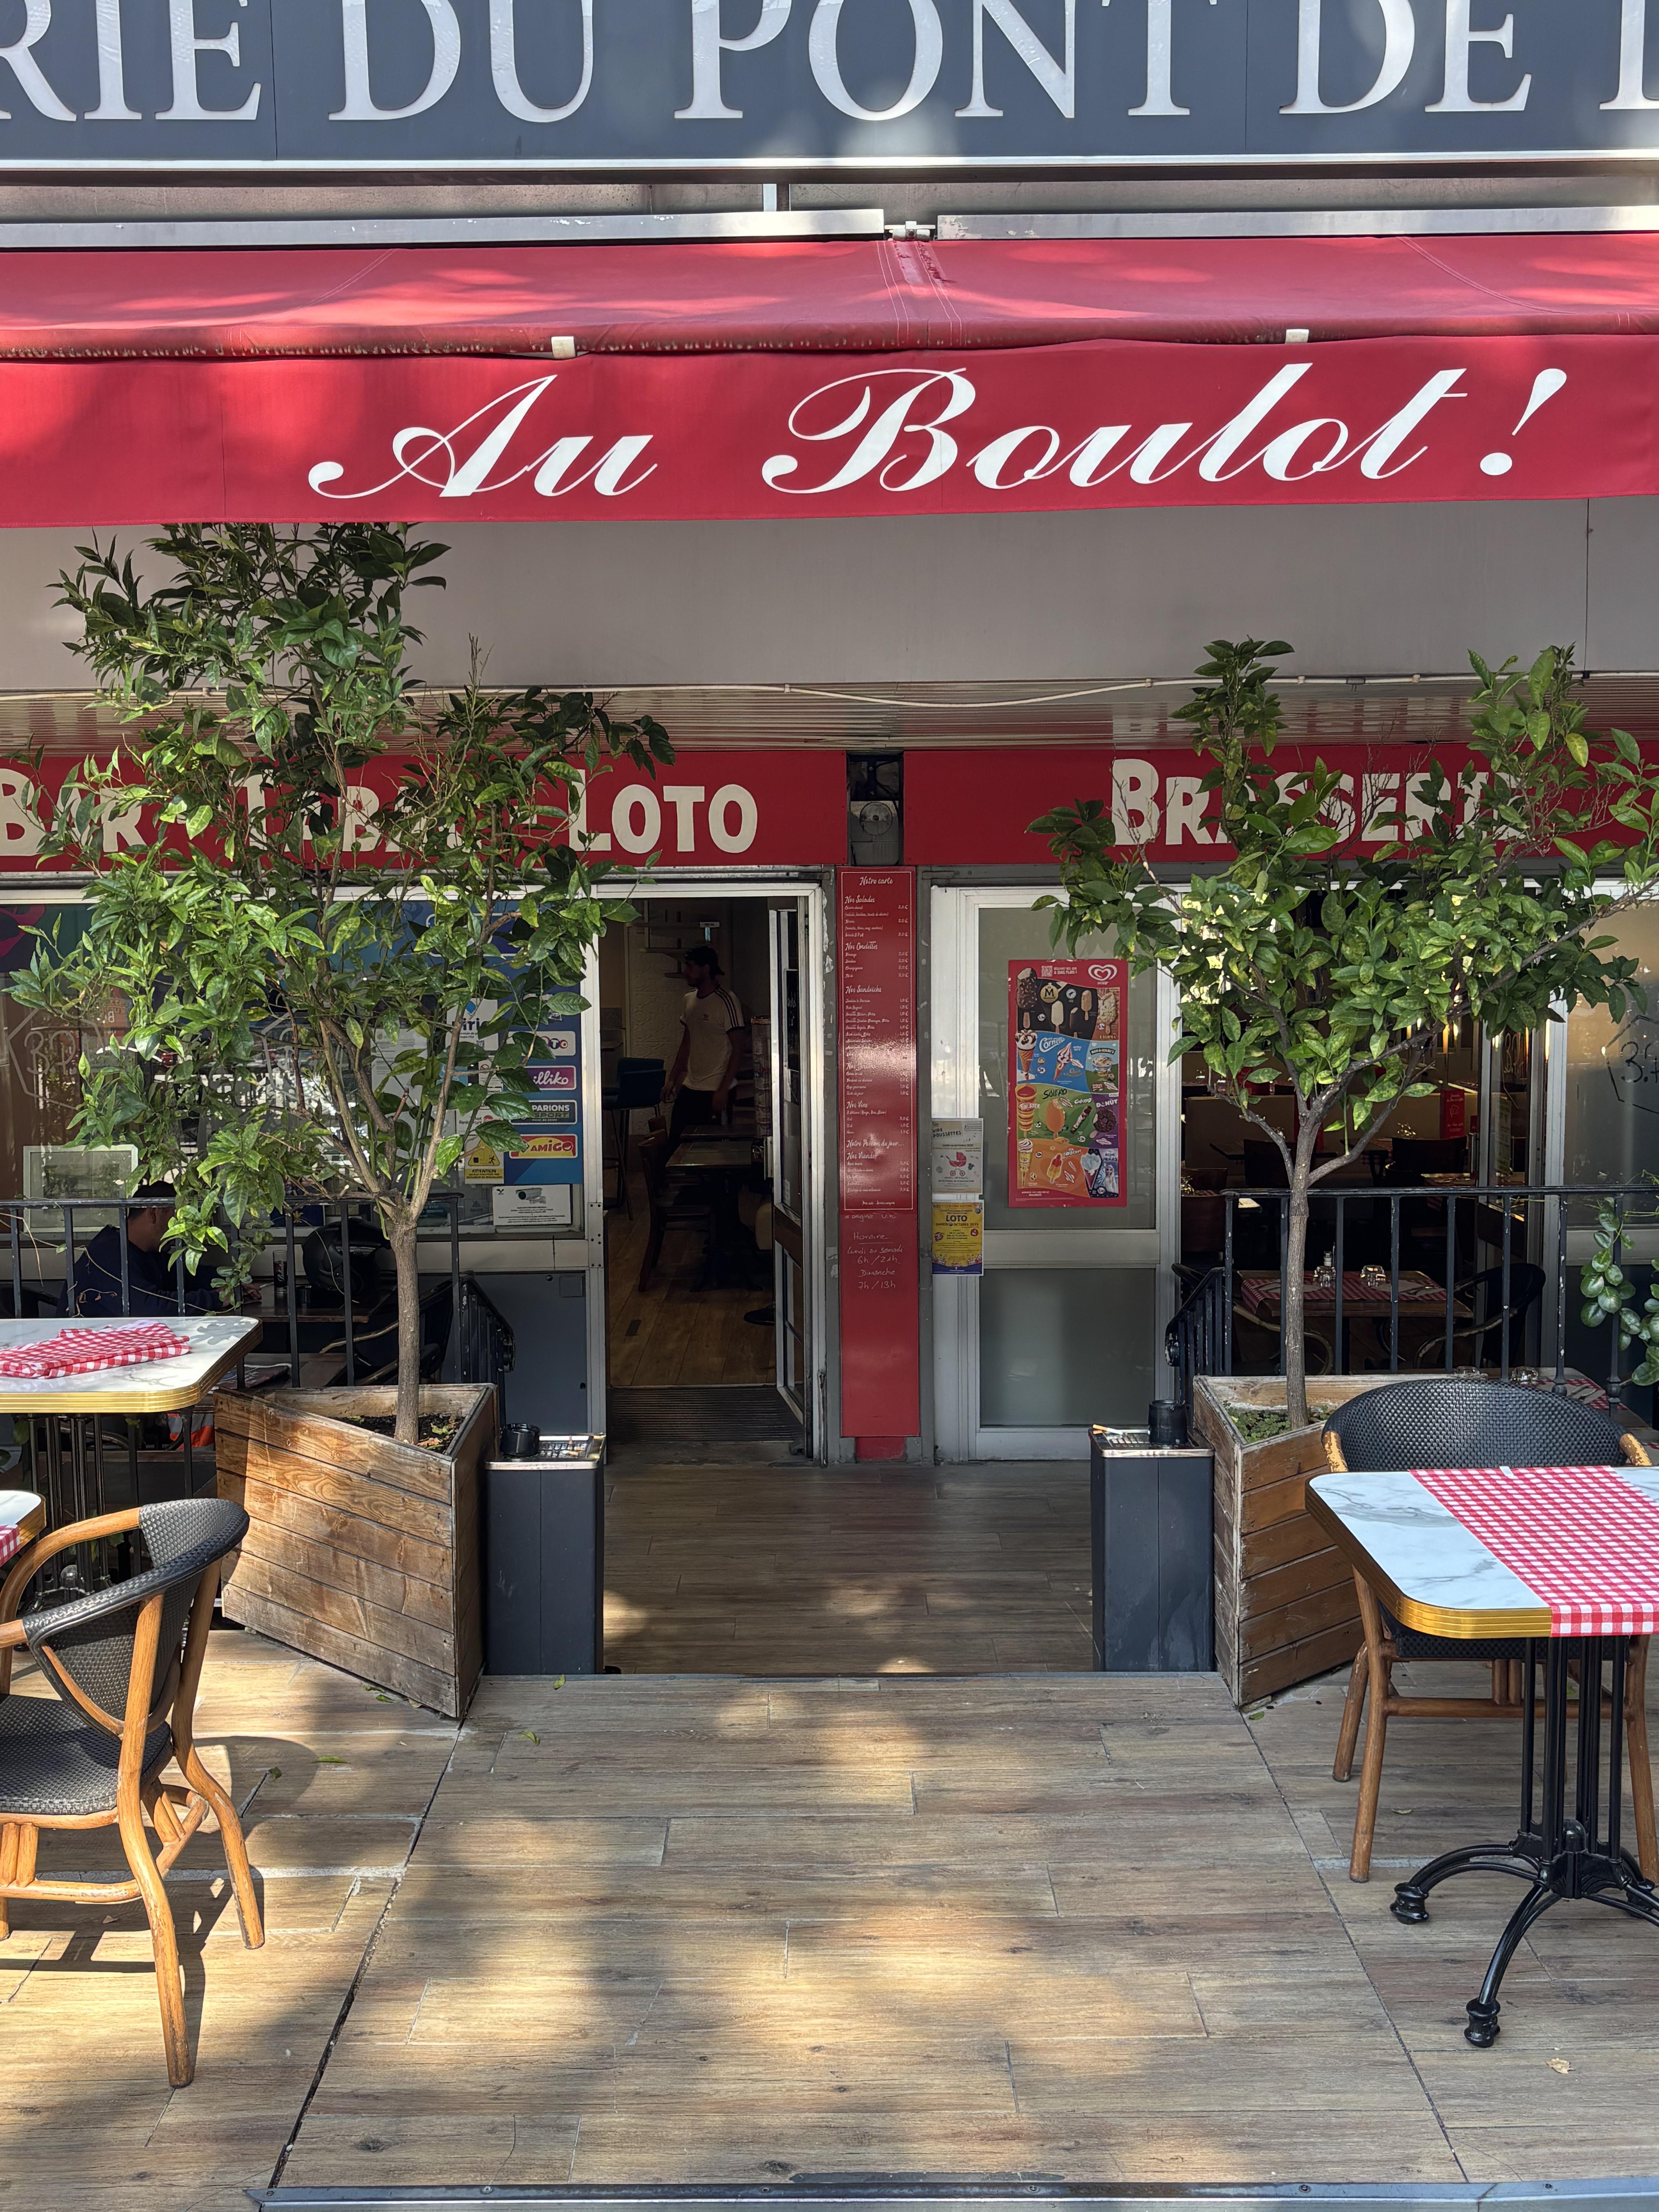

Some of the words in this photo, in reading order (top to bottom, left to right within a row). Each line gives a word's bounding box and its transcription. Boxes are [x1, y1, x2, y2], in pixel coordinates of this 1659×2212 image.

[328, 0, 594, 123] DU
[674, 0, 1218, 122] PONT
[1279, 0, 1532, 114] DE
[308, 374, 658, 500] Au
[761, 362, 1468, 495] Boulot
[568, 769, 757, 854] LOTO
[530, 1140, 573, 1153] AMIGO
[857, 1267, 896, 1277] Dimanche
[858, 1281, 869, 1290] 7h
[881, 1280, 896, 1289] 13h
